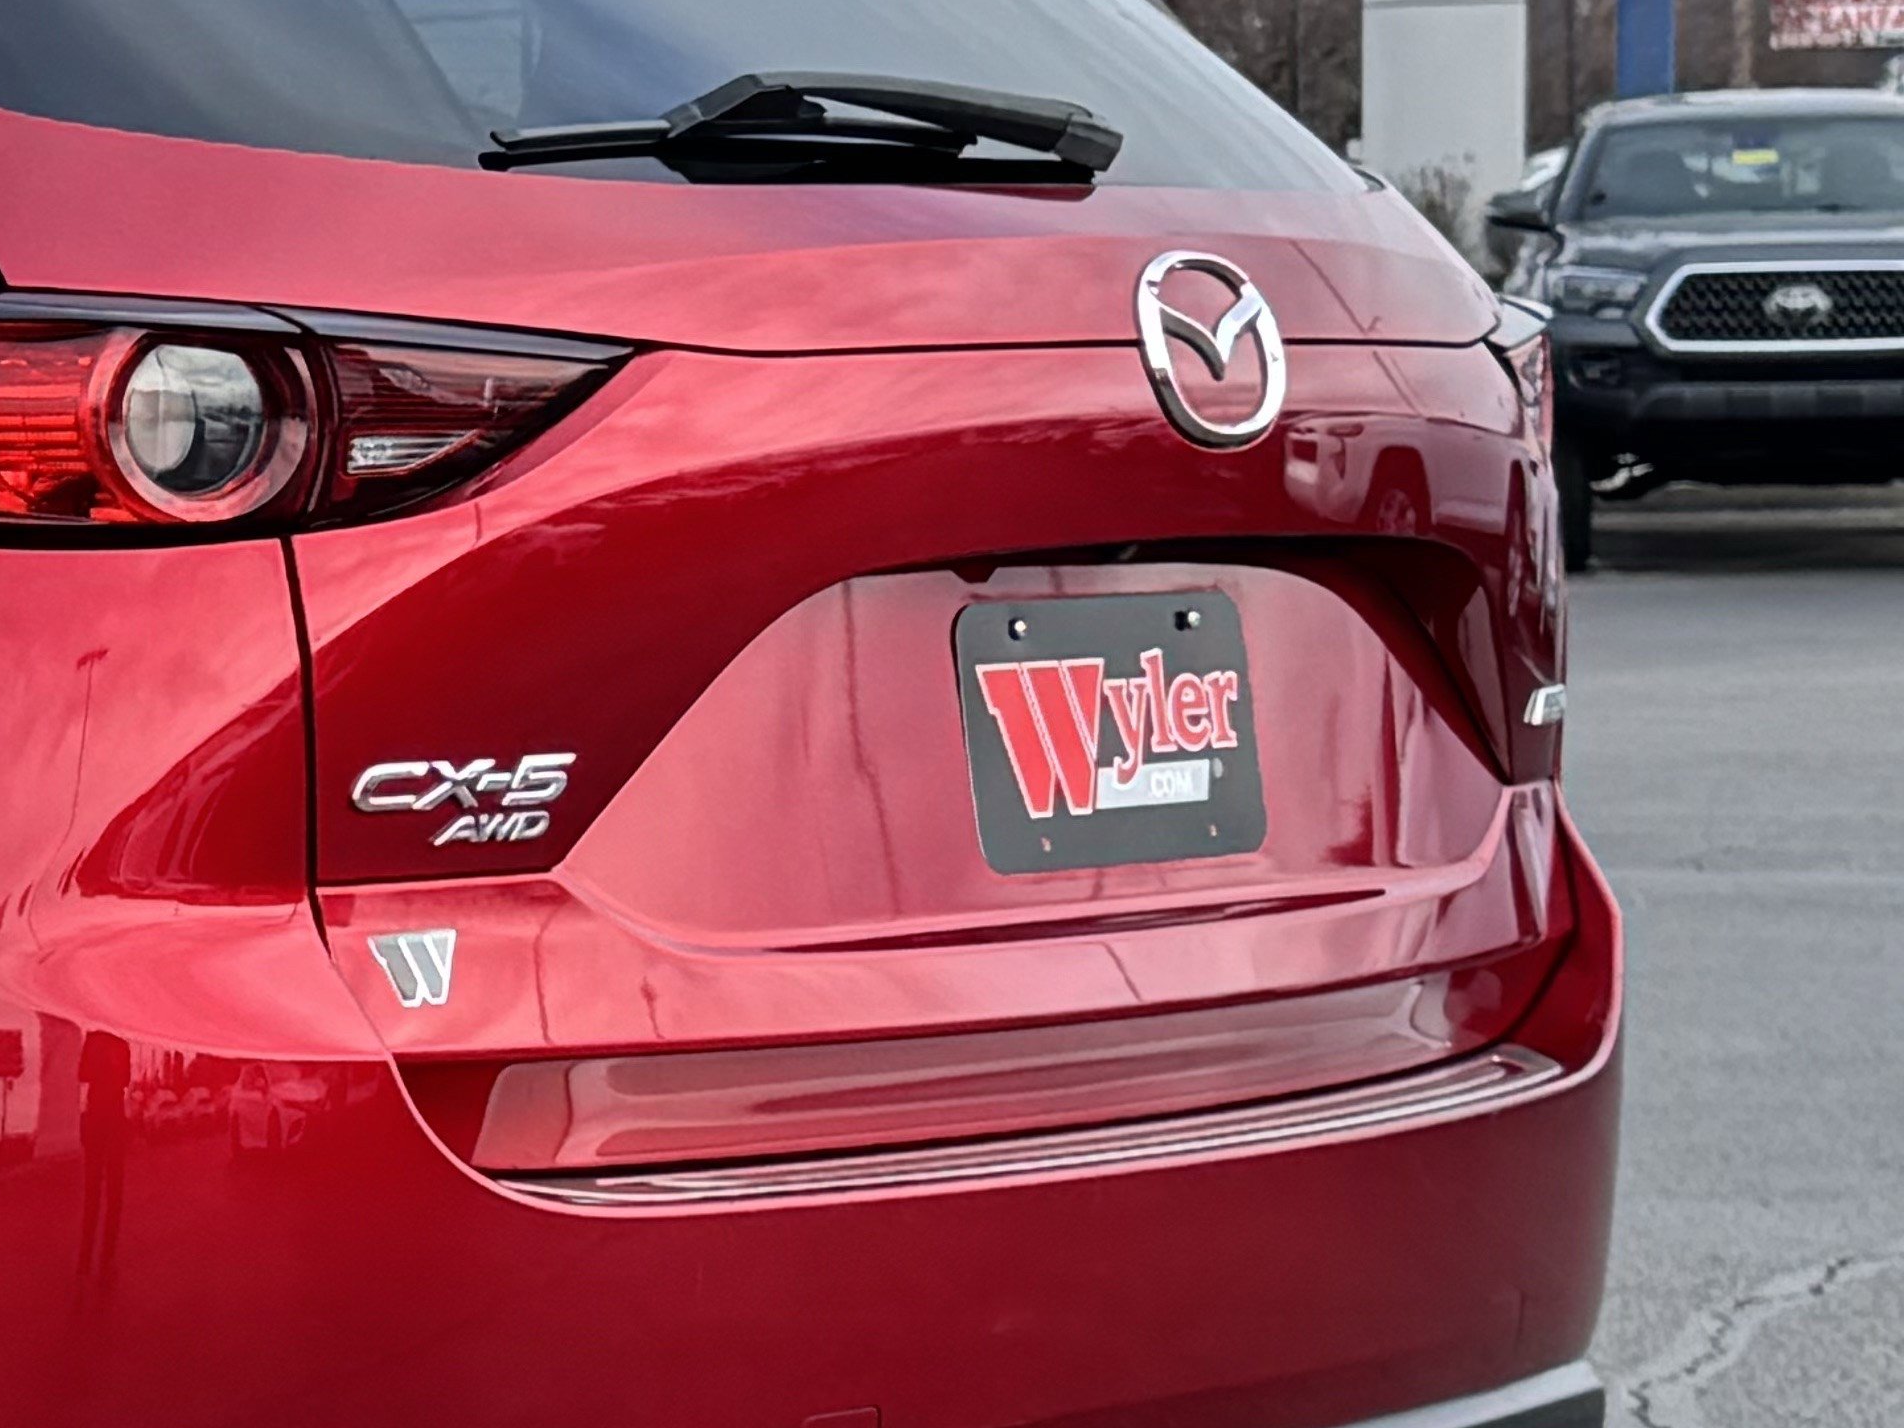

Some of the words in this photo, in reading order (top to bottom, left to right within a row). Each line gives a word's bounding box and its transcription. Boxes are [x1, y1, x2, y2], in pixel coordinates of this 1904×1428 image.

[975, 647, 1239, 819] Wyler
[350, 752, 578, 813] CX-5
[429, 810, 551, 847] AWD
